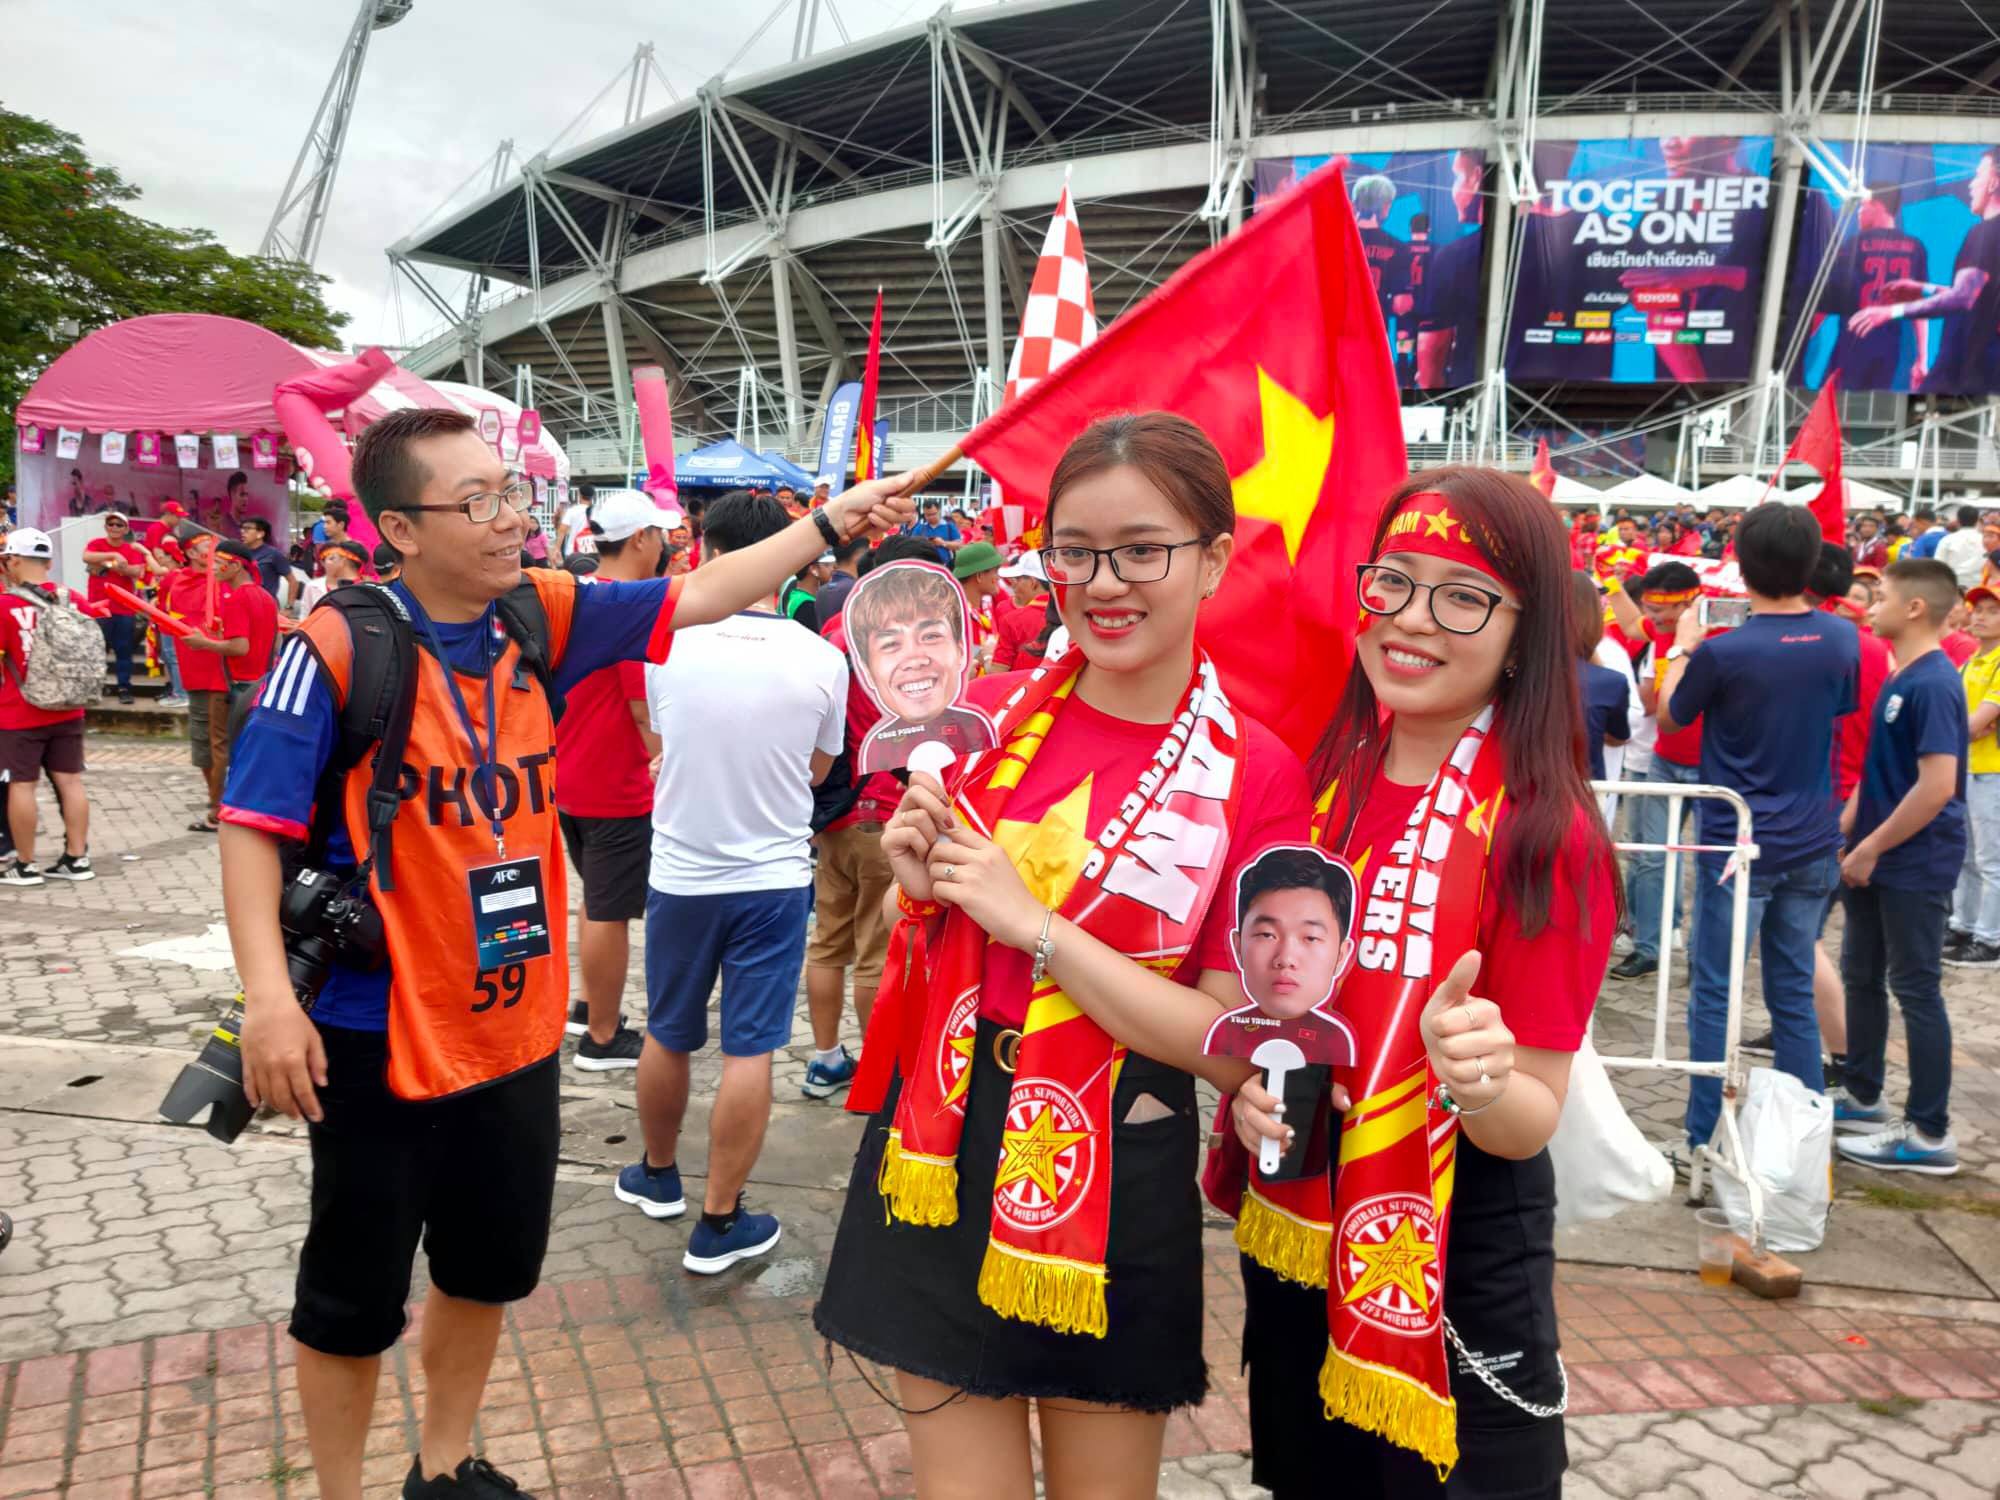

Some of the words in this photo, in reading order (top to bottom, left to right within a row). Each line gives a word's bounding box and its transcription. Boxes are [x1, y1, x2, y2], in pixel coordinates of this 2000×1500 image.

[1545, 177, 1770, 213] TOGETHER
[1573, 212, 1632, 245] AS
[1640, 211, 1735, 245] ONE
[398, 745, 557, 826] PHOT
[491, 869, 521, 885] AFC
[470, 961, 526, 1012] 59
[1034, 1087, 1081, 1128] SUPPORTERS
[1345, 1204, 1386, 1239] FOOTBALL
